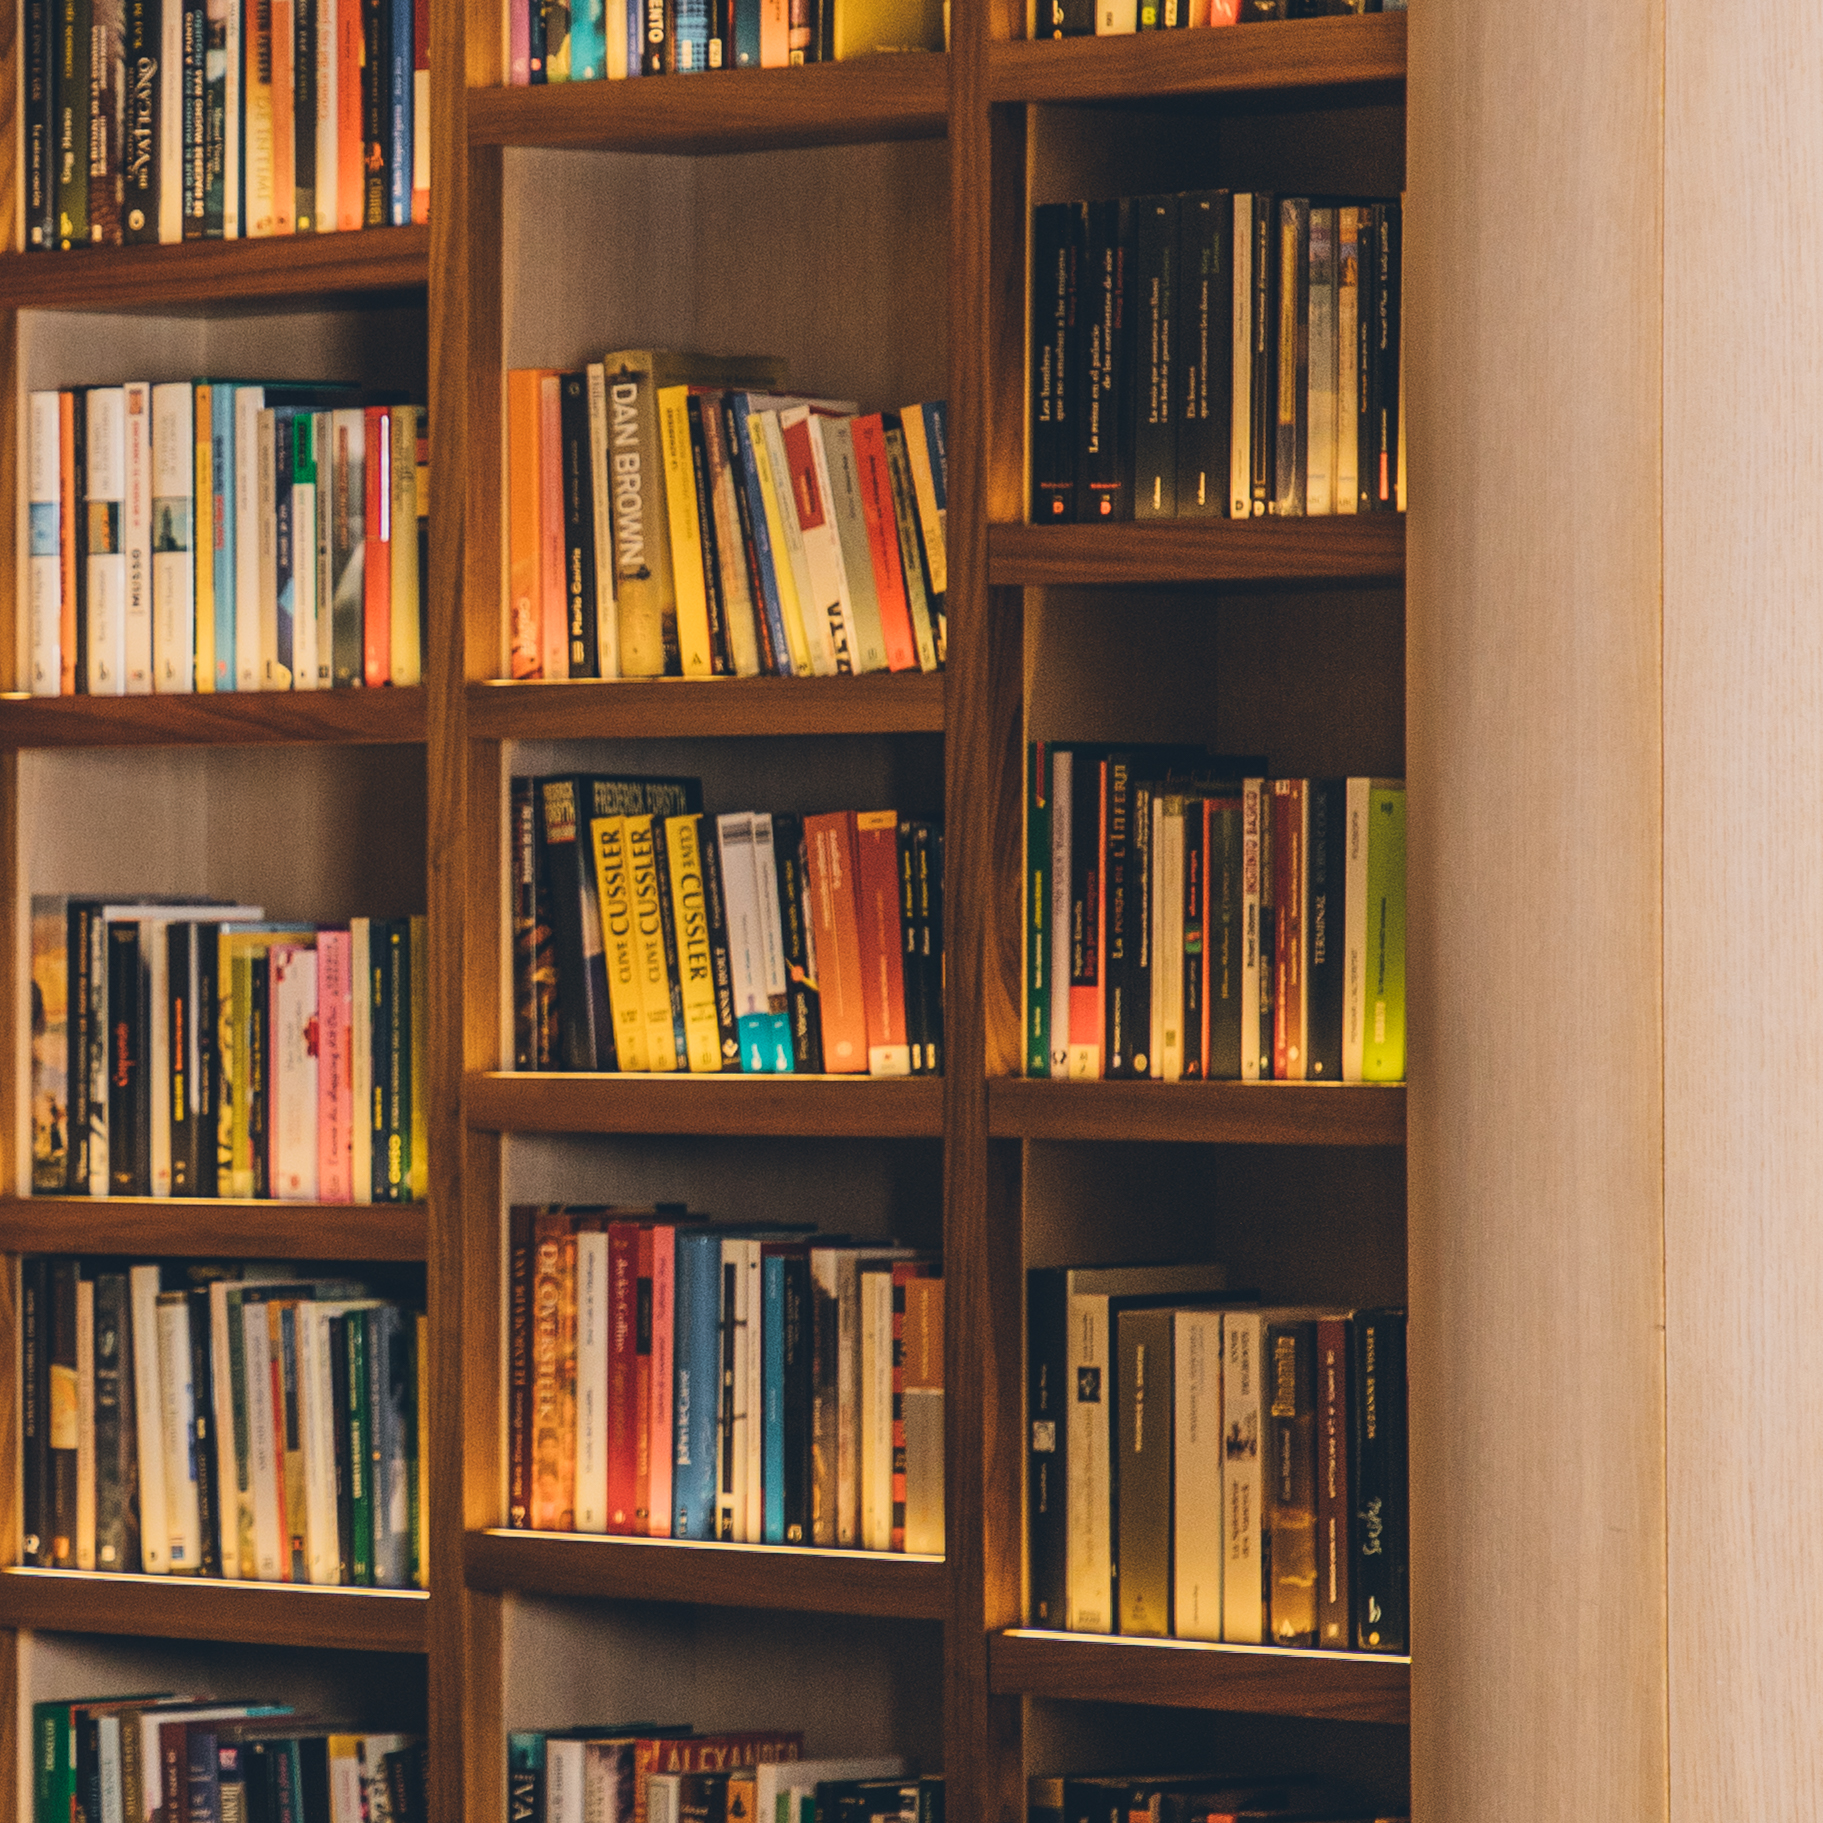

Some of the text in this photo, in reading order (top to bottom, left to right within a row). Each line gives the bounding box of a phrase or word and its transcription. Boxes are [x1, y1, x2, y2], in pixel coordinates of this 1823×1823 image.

[131, 57, 158, 173] VATICANO
[612, 383, 645, 566] DAN BROWN
[132, 549, 141, 607] MUSSO
[601, 831, 632, 984] CLIVE CUSSLER
[631, 829, 661, 984] CLIVE CUSSLER
[679, 826, 708, 980] CLIVE CUSSLER
